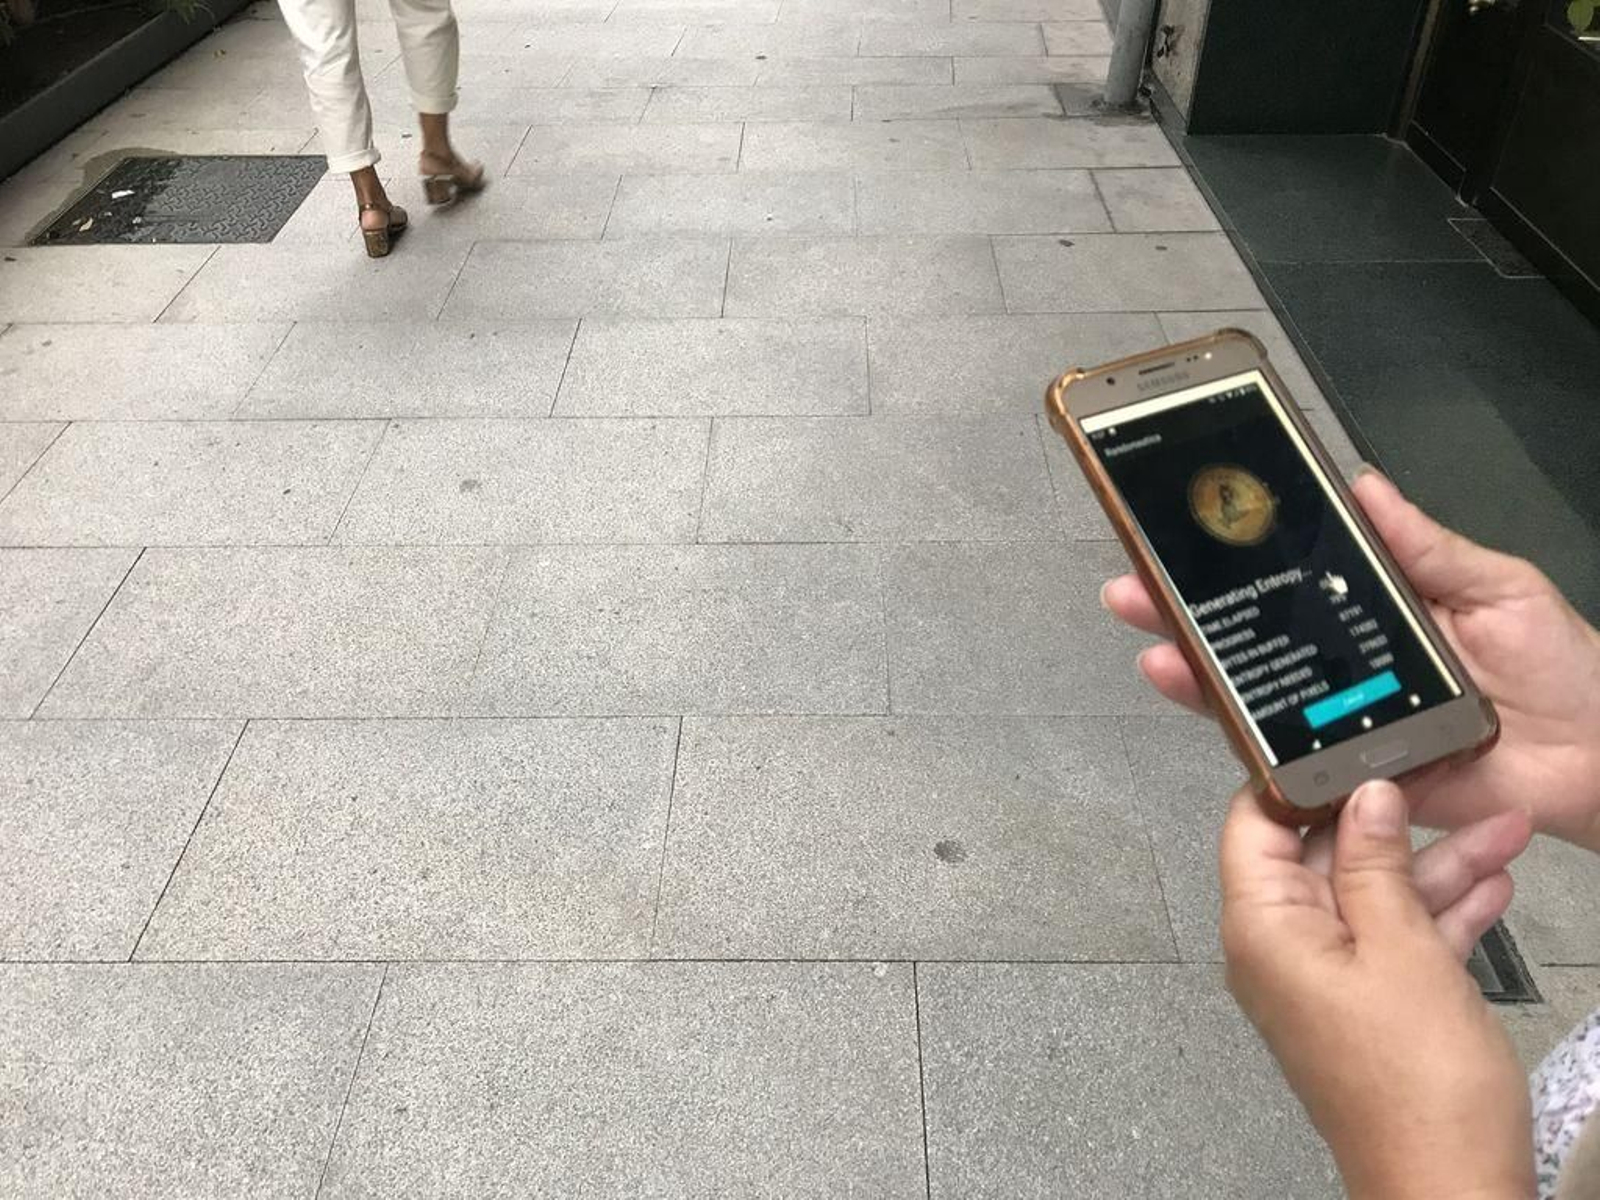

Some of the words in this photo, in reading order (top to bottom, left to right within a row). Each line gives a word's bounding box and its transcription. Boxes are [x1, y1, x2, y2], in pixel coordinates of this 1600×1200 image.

[1190, 584, 1259, 619] Generating
[1222, 605, 1261, 627] ELAPSED
[1269, 643, 1319, 671] GENERATED
